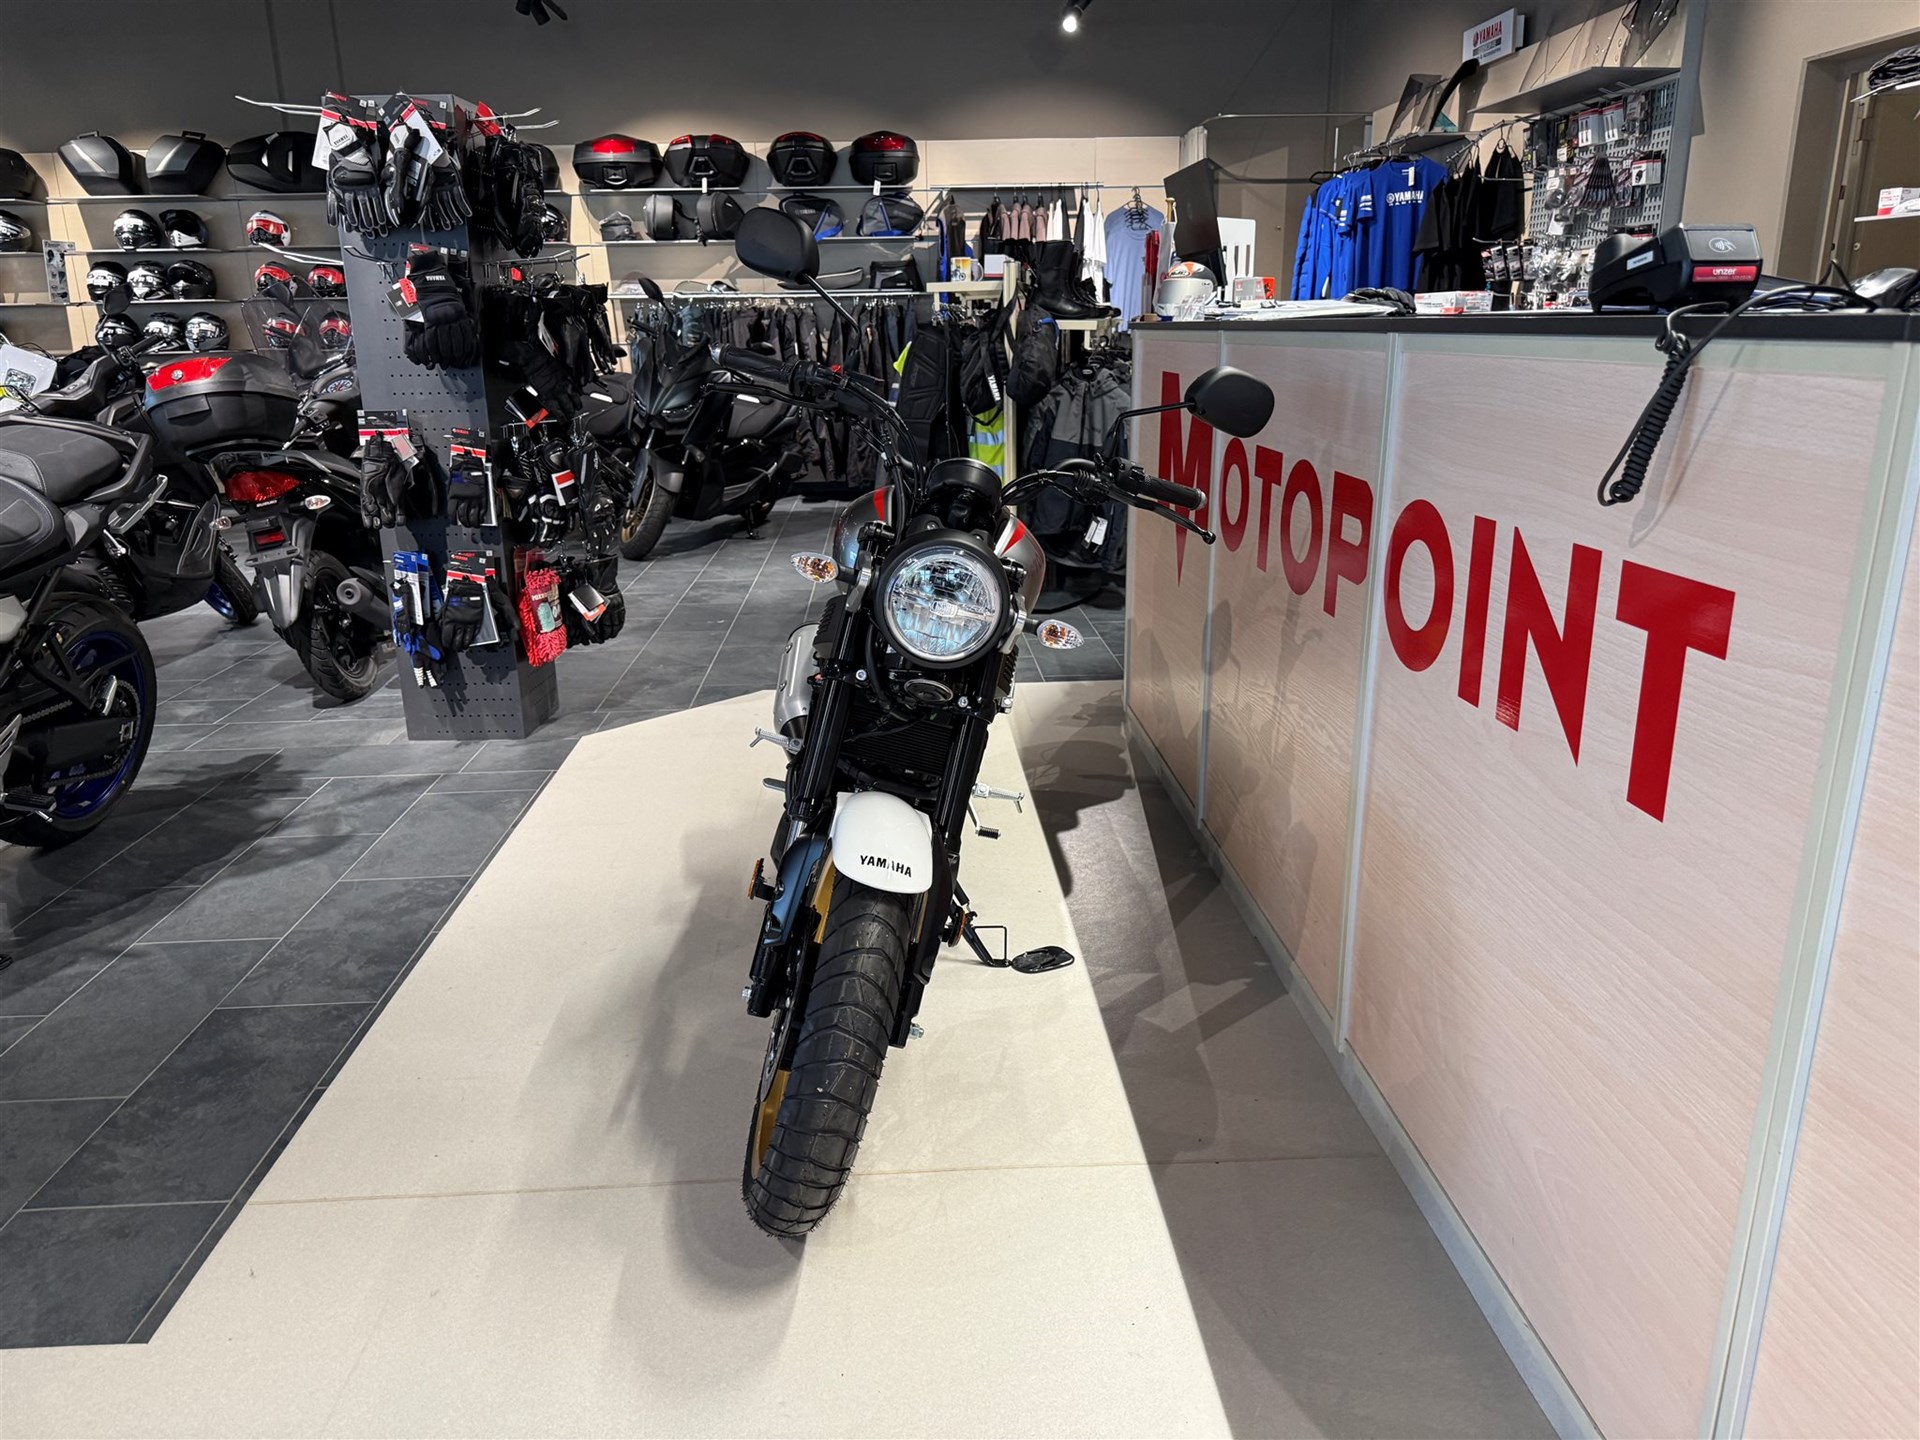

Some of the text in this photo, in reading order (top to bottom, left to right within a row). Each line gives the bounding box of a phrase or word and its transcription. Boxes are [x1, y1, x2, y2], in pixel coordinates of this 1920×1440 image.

[1480, 20, 1502, 44] YAMAHA
[1712, 267, 1737, 276] unzer
[987, 374, 1001, 402] YAMAHA
[860, 854, 912, 878] YAMAHA
